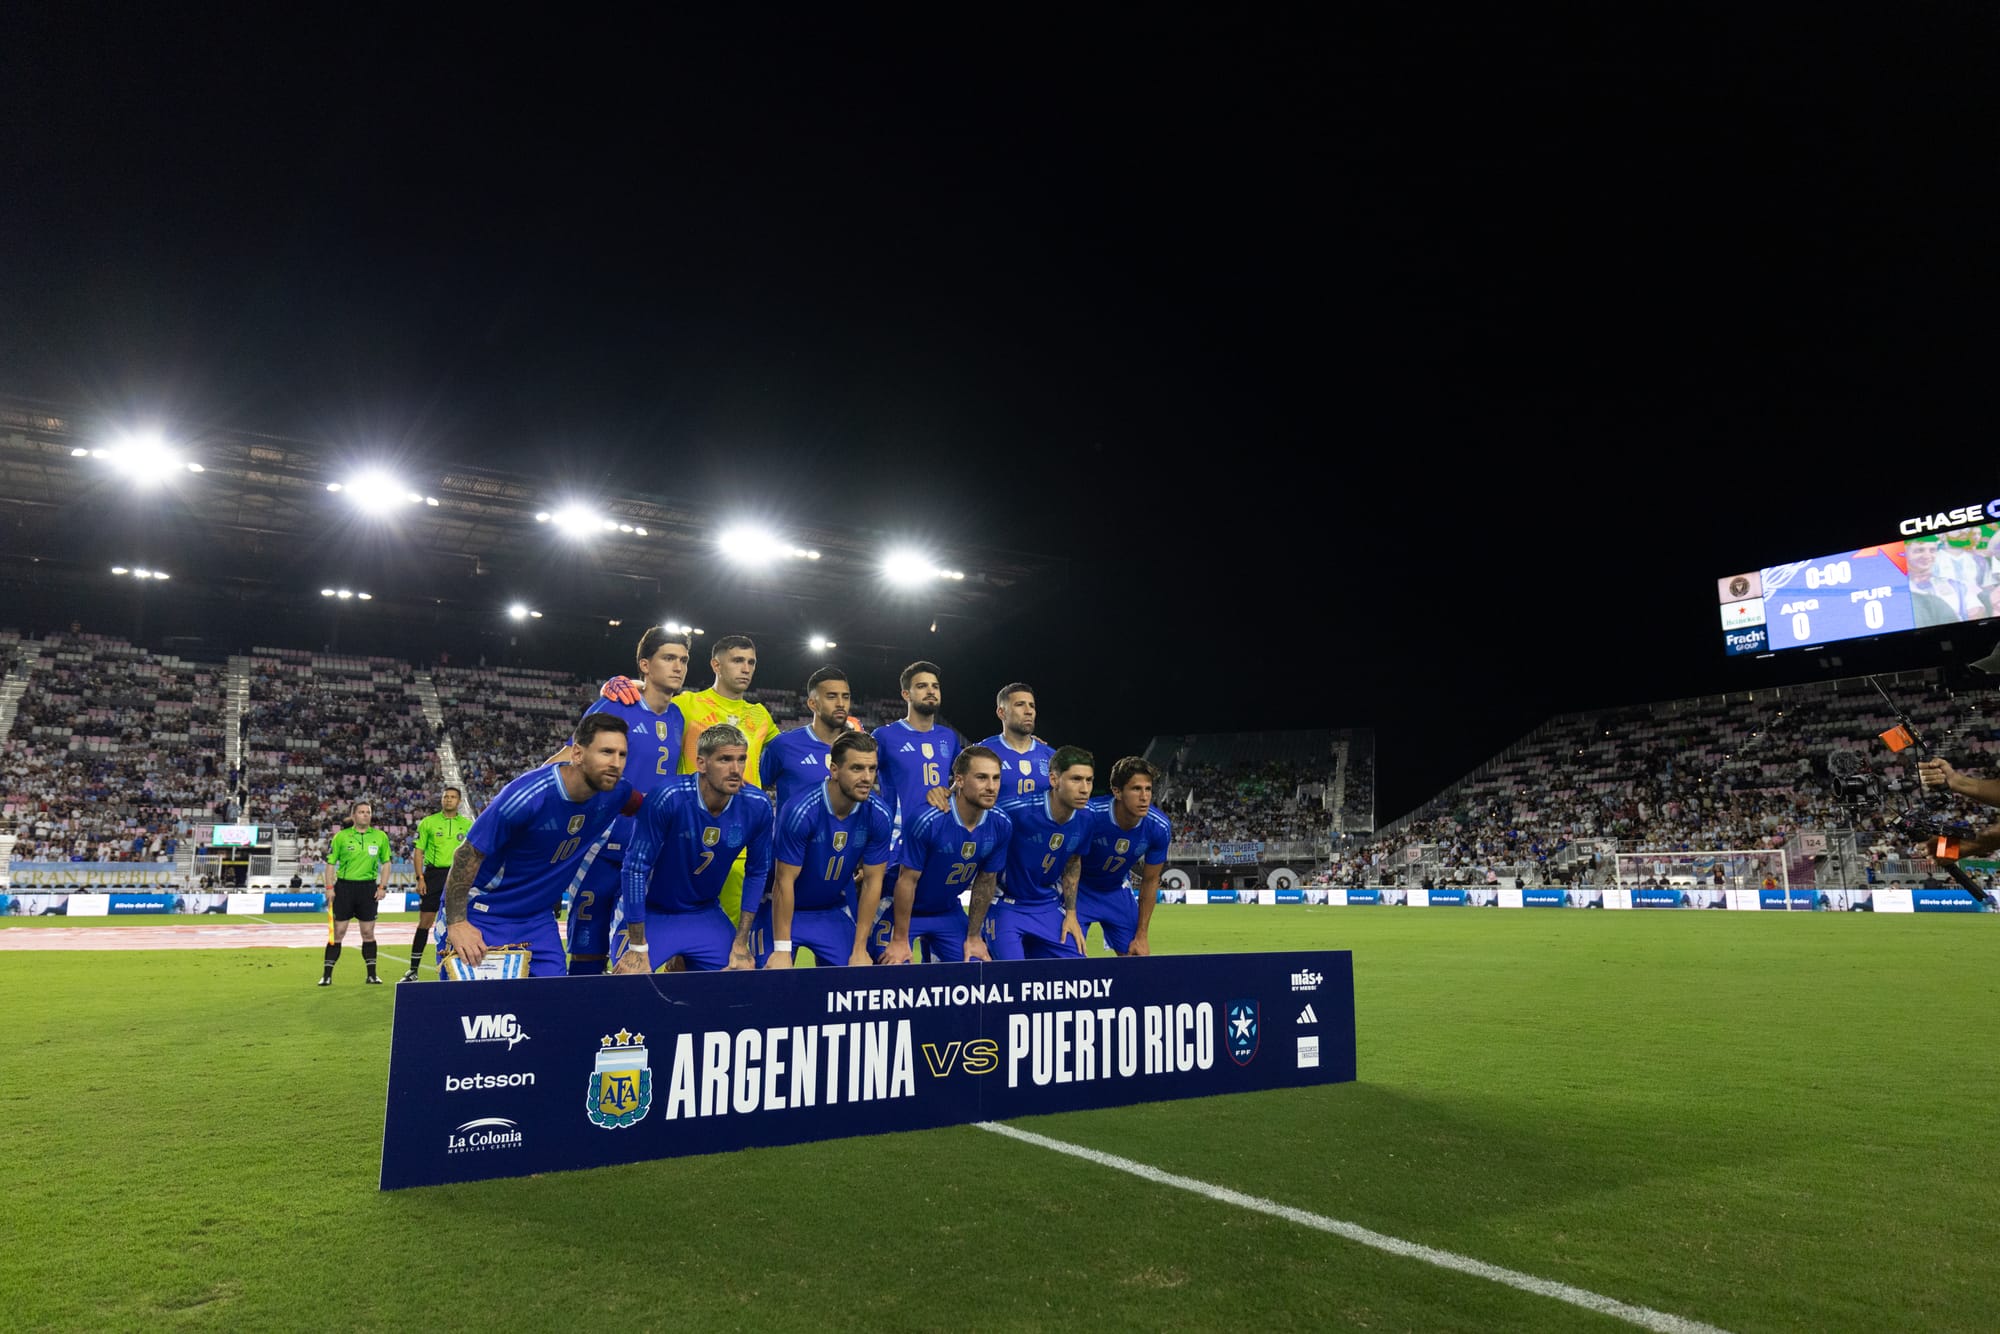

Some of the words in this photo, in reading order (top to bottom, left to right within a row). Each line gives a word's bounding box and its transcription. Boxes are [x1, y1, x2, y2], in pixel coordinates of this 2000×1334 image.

[1900, 504, 1984, 535] CHASE
[1805, 561, 1852, 589] 0:00
[1780, 598, 1819, 615] ARG
[1851, 586, 1892, 603] PUR
[1792, 612, 1811, 640] 0
[1863, 600, 1884, 629] 0
[1726, 630, 1766, 645] Fracht
[656, 746, 669, 775] 2
[923, 762, 941, 786] 16
[550, 837, 581, 864] 10
[1806, 839, 1821, 847] 124
[693, 851, 715, 875] 7
[824, 855, 845, 880] 11
[945, 863, 977, 885] 20
[1041, 853, 1056, 874] 4
[1102, 855, 1126, 873] 17
[12, 869, 79, 885] GRAN
[85, 869, 171, 886] PUEBLO
[577, 890, 595, 920] 2
[616, 929, 630, 958] 7
[876, 920, 894, 947] 2
[827, 982, 1014, 1012] INTERNATIONAL
[1021, 978, 1113, 1002] FRIENDLY
[461, 1014, 516, 1039] VMG
[665, 1019, 915, 1120] ARGENTINA
[921, 1039, 999, 1077] VS
[1008, 1006, 1137, 1088] PUERTO
[1144, 1002, 1214, 1074] RICO
[445, 1072, 535, 1091] betsson
[600, 1075, 637, 1110] AFA
[447, 1145, 486, 1154] MEDICAL
[490, 1141, 522, 1150] CENTER
[448, 1135, 466, 1148] La
[469, 1129, 522, 1146] Colonia
